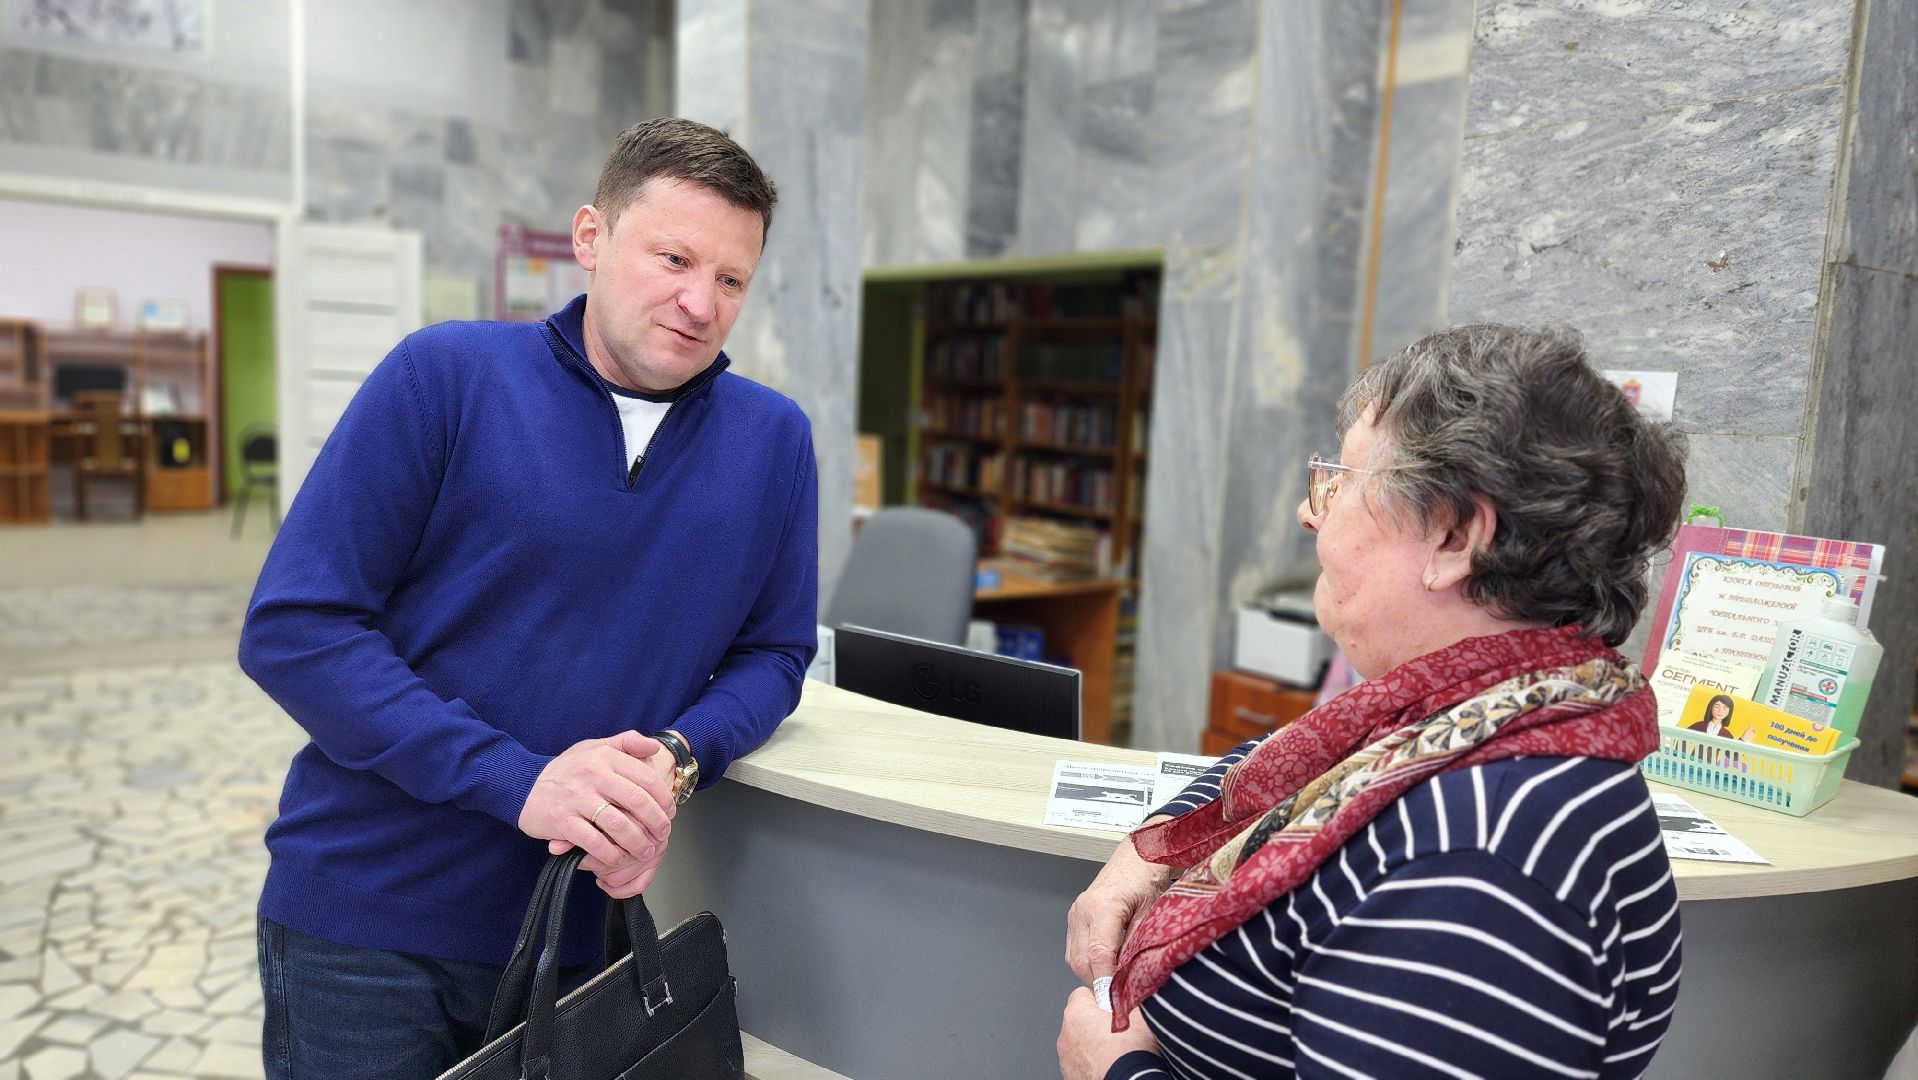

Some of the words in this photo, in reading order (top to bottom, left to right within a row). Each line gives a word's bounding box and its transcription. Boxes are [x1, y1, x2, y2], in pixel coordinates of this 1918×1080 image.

[1755, 580, 1801, 592] ОТЗЫВОВ
[1769, 629, 1802, 706] MANUFACTOR
[950, 677, 981, 705] LG
[1770, 721, 1784, 731] 100
[1785, 727, 1805, 739] дней
[1805, 735, 1818, 743] до
[1767, 734, 1810, 753] получения
